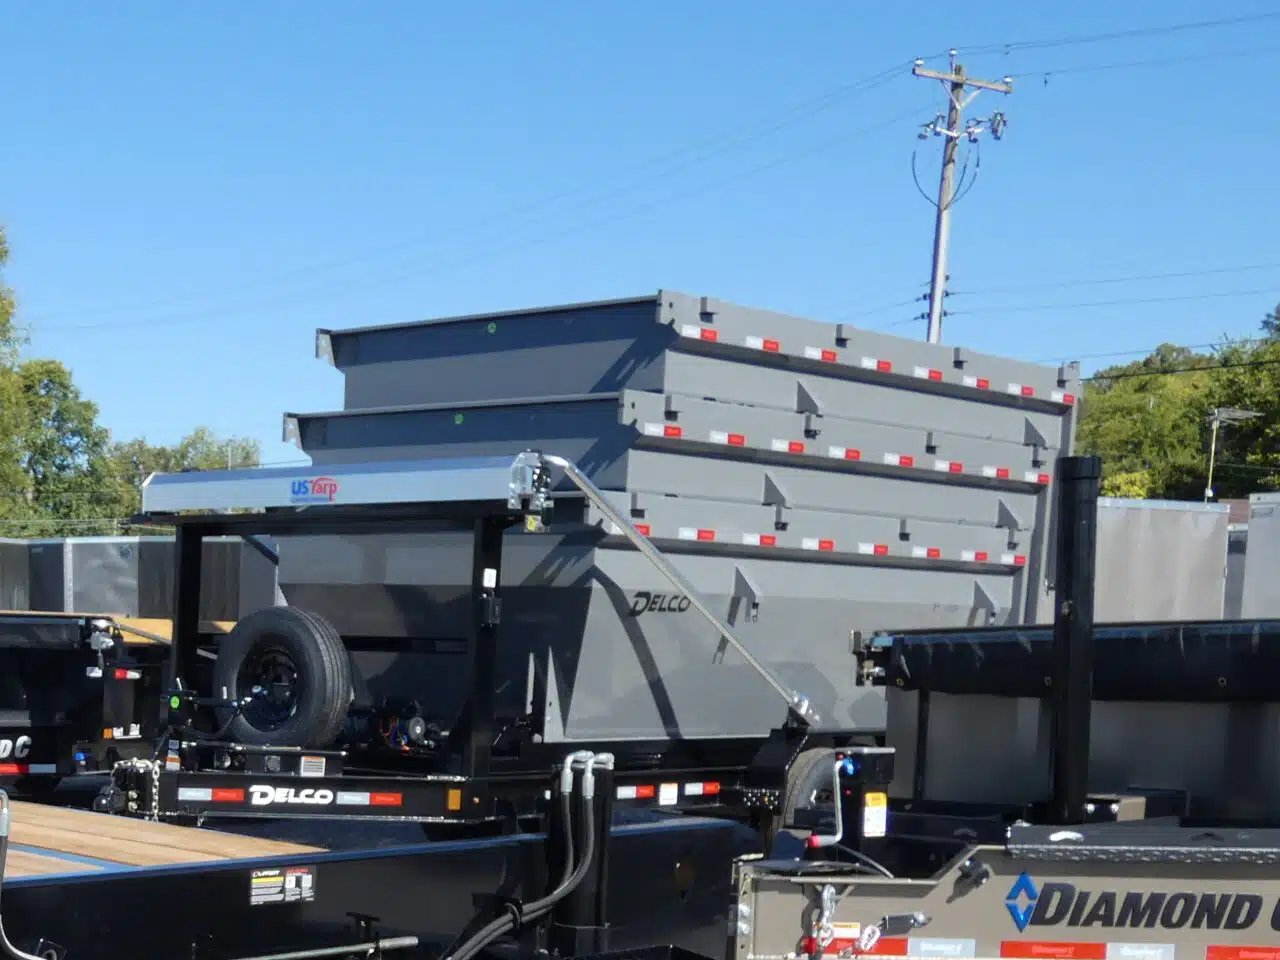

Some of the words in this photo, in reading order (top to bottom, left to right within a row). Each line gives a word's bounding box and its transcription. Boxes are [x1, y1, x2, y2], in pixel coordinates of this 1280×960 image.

[628, 591, 691, 617] DELCO
[14, 735, 32, 759] C
[248, 784, 334, 806] DELCO
[1028, 881, 1264, 931] DIAMOND
